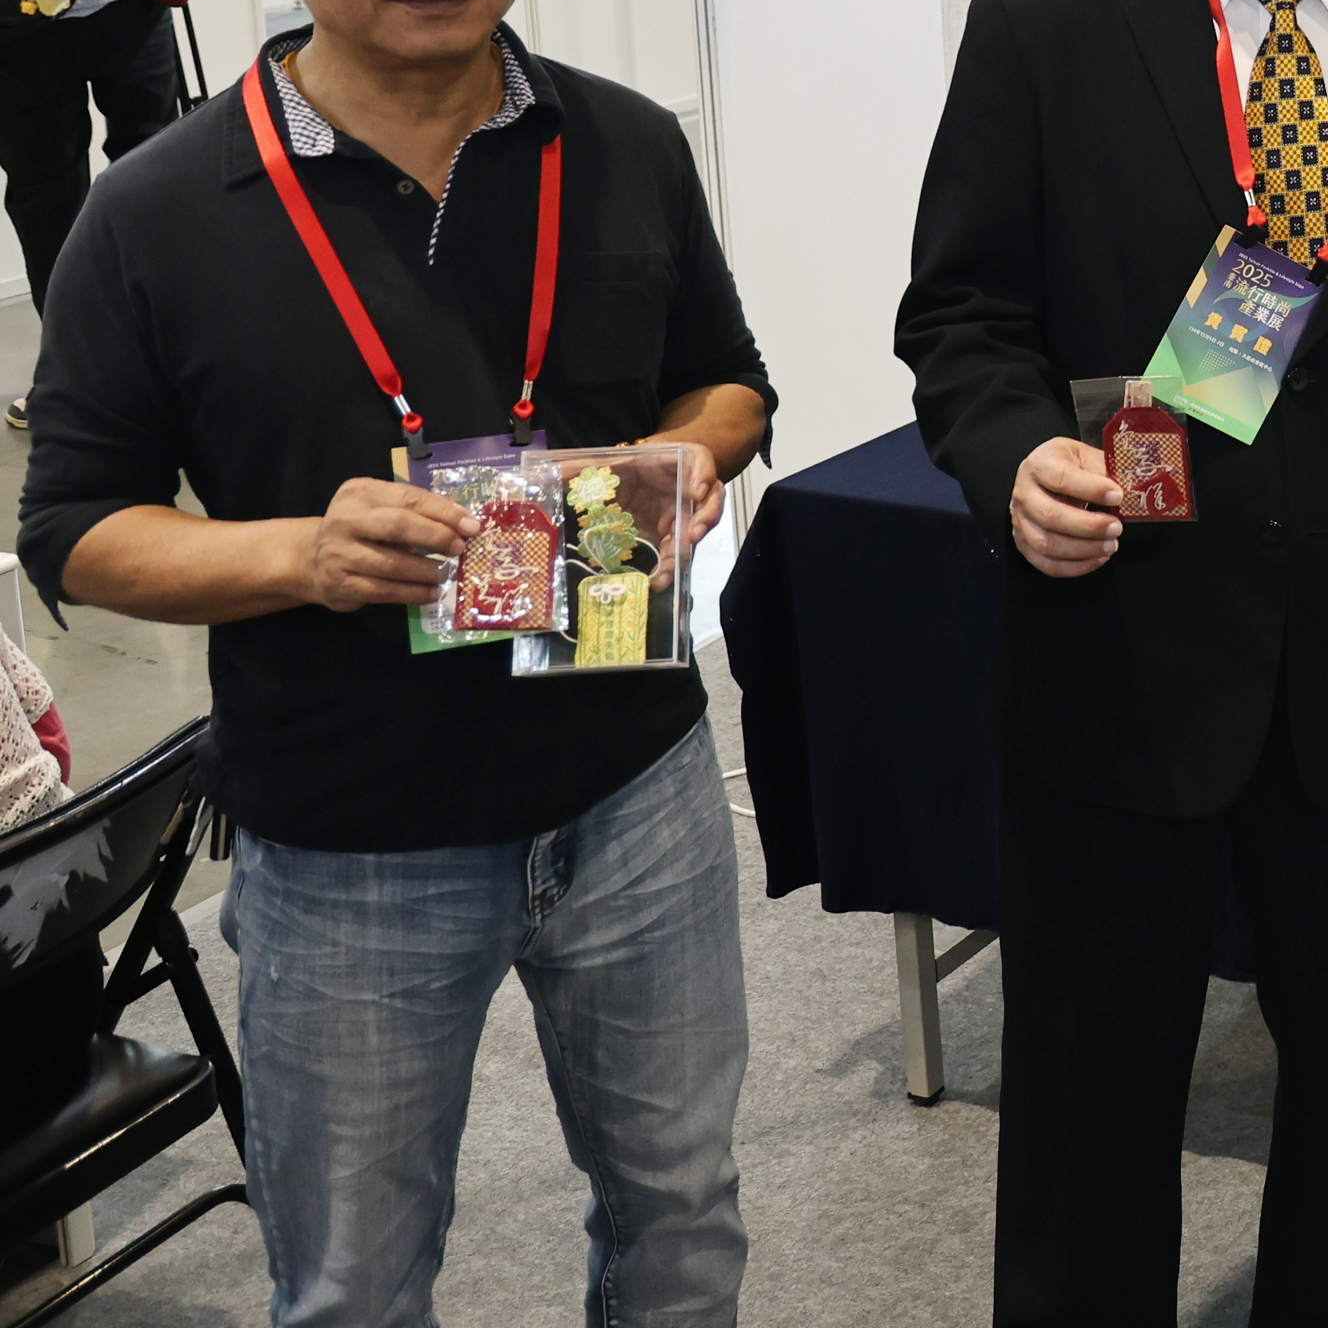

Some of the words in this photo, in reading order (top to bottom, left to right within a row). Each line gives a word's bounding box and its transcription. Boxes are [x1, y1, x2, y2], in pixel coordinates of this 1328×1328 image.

[1232, 259, 1274, 288] 2025
[1233, 277, 1292, 318] 流行時尚
[1238, 299, 1285, 332] 產業展
